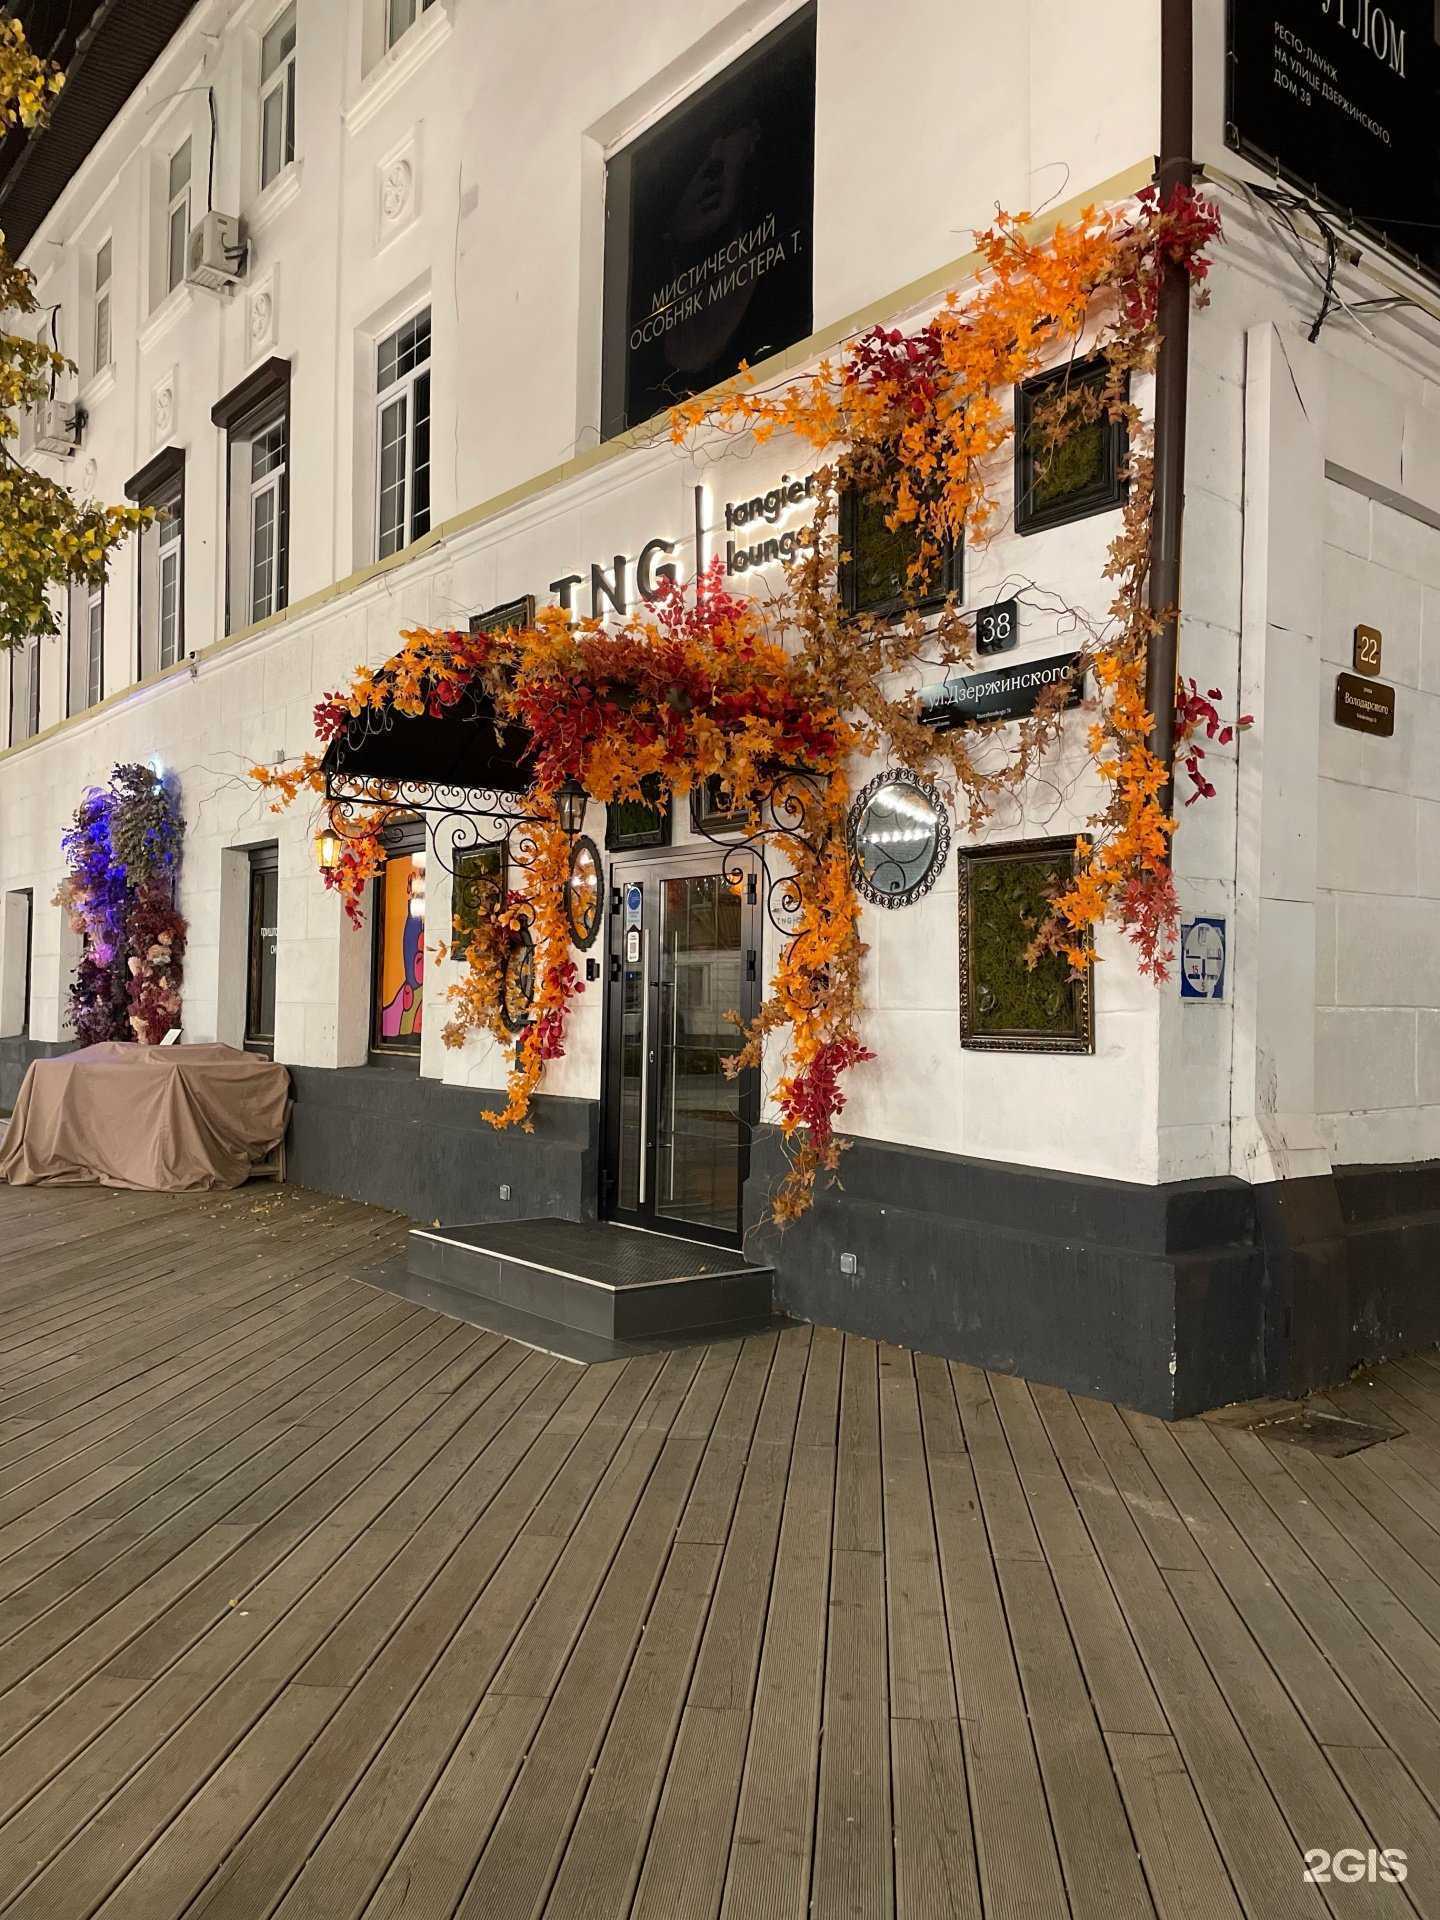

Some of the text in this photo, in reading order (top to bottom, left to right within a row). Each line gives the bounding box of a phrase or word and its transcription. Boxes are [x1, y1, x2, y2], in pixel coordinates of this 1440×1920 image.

[1274, 21, 1338, 82] РЕСТО-ЛАУНЖ
[1274, 45, 1288, 66] НА
[1290, 56, 1320, 91] УЛИЦЕ
[1273, 69, 1312, 106] ДОМ 38
[651, 212, 776, 312] МИСТИЧЕСКИЙ
[630, 290, 703, 350] ОСОБНЯК
[708, 242, 786, 305] МИСТЕРА
[549, 538, 677, 621] TNG
[982, 612, 1011, 643] 38
[1360, 636, 1377, 665] 22
